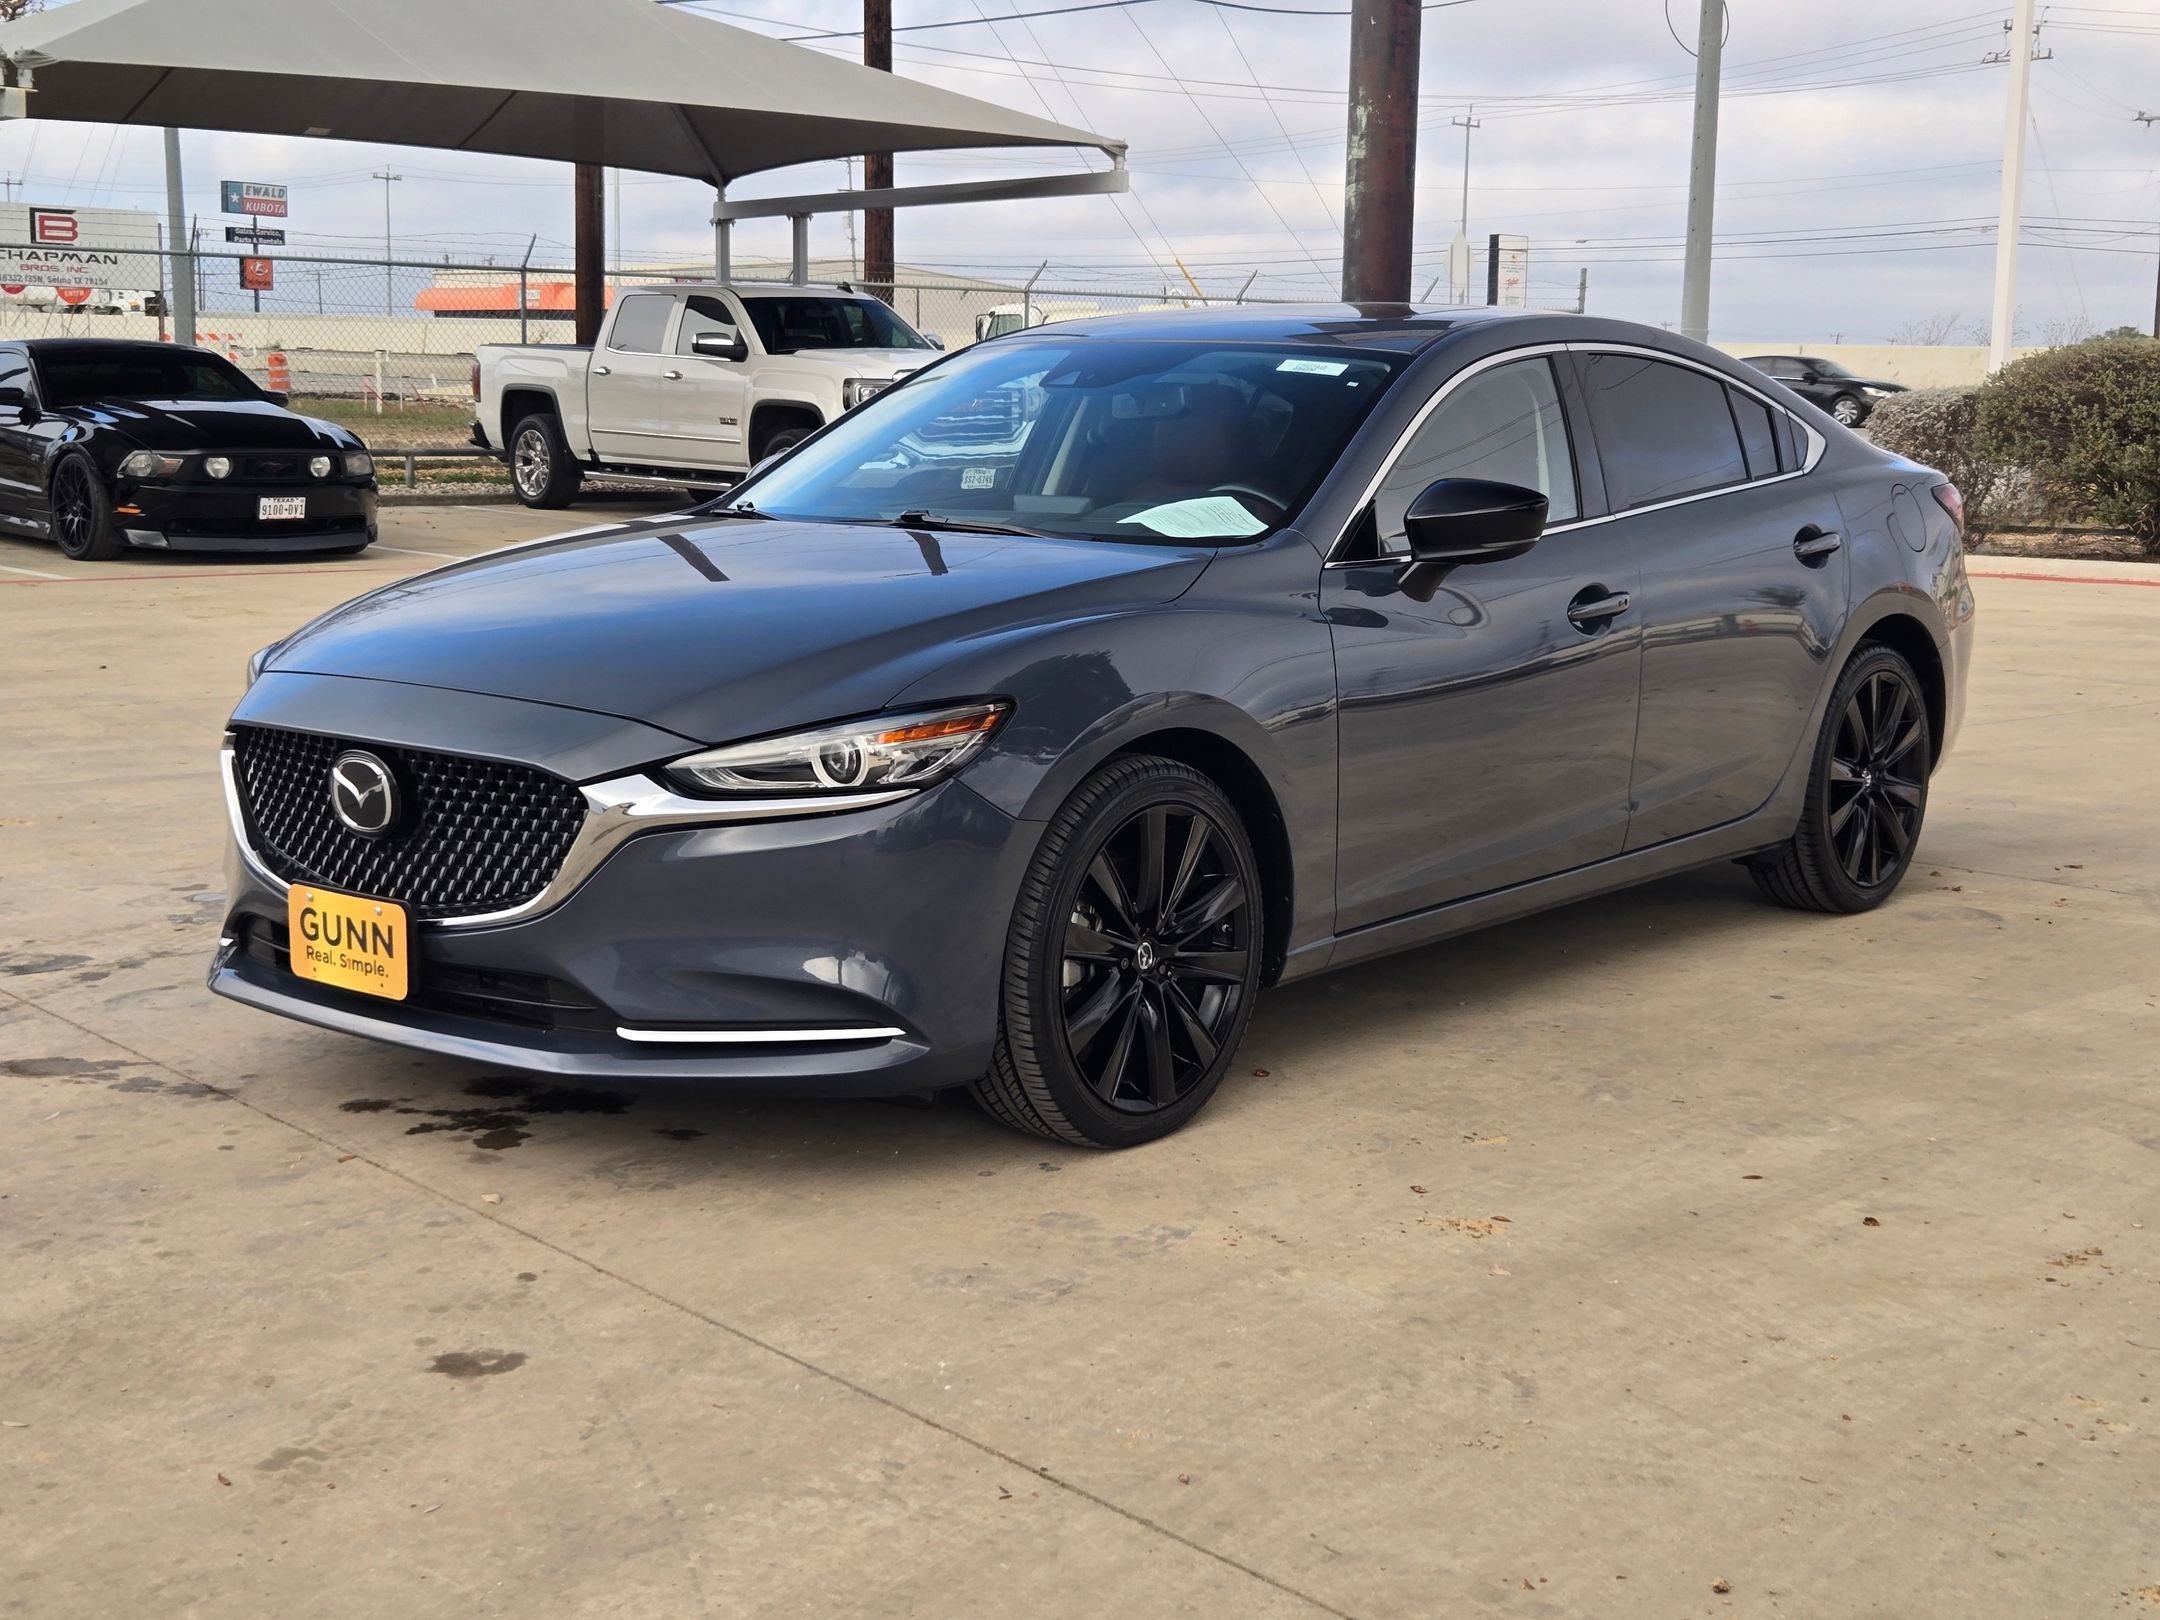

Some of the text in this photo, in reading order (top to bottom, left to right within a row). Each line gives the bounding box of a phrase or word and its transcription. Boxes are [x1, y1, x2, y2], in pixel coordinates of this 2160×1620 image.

[245, 185, 286, 198] EWALD
[245, 202, 286, 214] KUBOTA
[47, 275, 72, 285] Selma
[74, 277, 83, 285] TX
[300, 907, 394, 959] GUNN
[306, 945, 337, 966] Real.
